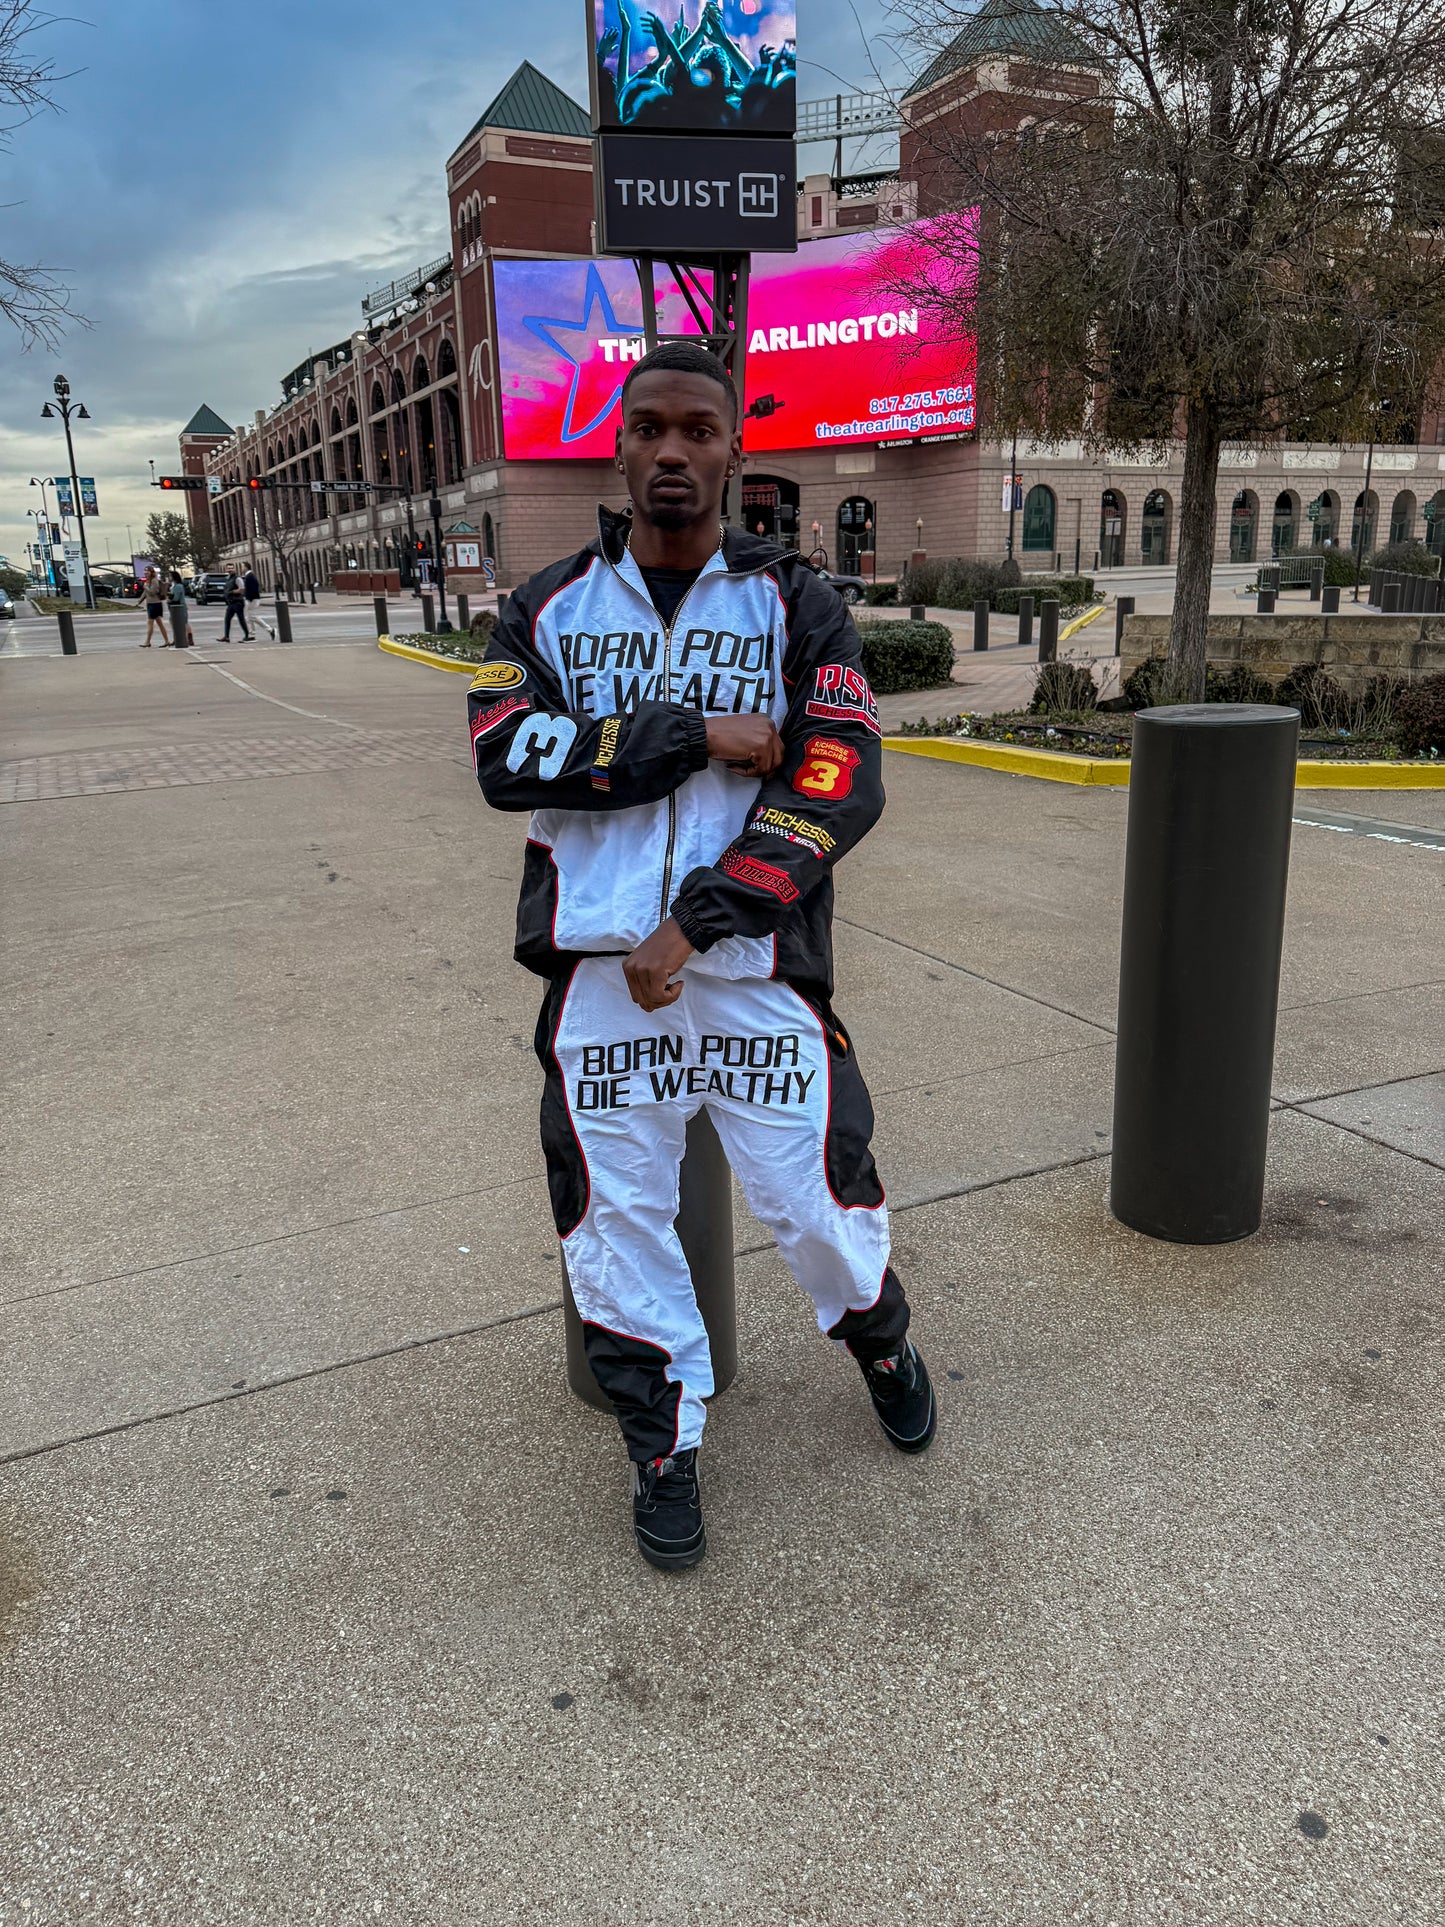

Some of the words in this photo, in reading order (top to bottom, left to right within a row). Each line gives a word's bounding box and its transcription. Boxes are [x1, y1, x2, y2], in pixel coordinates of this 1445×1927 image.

[614, 178, 731, 208] TRUIST
[748, 308, 919, 354] ARLINGTON
[869, 385, 973, 414] 817.275.7661
[815, 406, 974, 438] theatrearlington.org
[506, 712, 577, 781] 3
[814, 741, 849, 756] RICHESSE
[801, 760, 840, 792] 3
[762, 808, 837, 852] RICHESSE
[793, 836, 820, 854] RACING
[582, 1034, 683, 1076] BORN
[699, 1034, 799, 1068] POOR
[576, 1075, 631, 1110] DIE
[649, 1066, 816, 1105] WEALTHY
